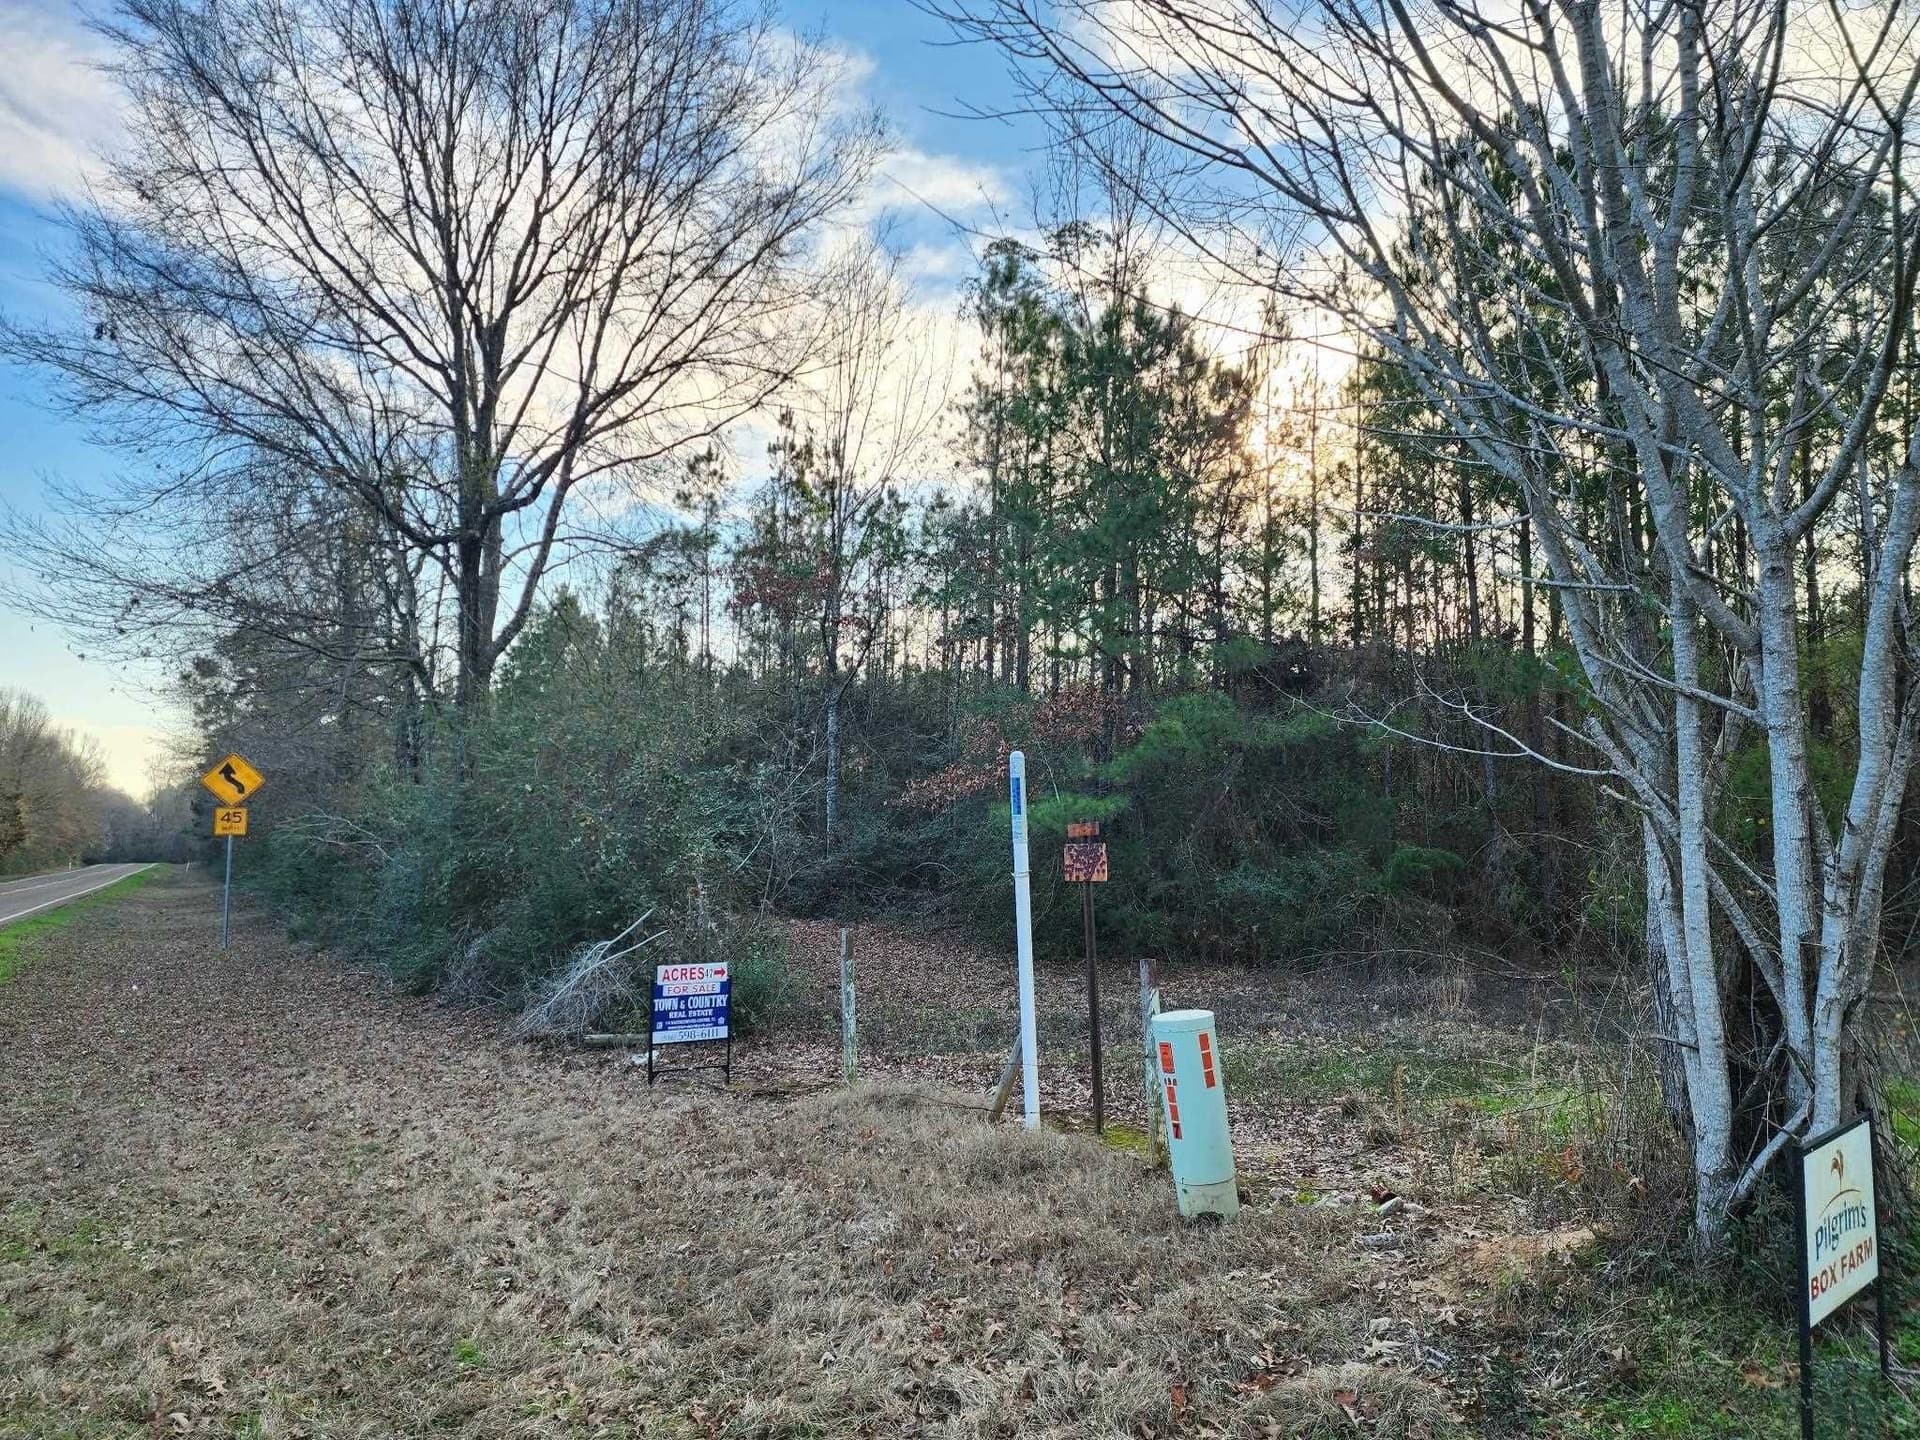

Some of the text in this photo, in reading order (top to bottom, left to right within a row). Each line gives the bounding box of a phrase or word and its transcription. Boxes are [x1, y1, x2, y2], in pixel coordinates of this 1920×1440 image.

[221, 811, 242, 823] 45
[663, 967, 705, 982] ACRES
[667, 984, 716, 994] FOR SALE
[654, 995, 728, 1011] TOWN & COUNTRY
[688, 1009, 713, 1017] ESTATE
[1815, 1200, 1866, 1261] Pilgrim's
[1810, 1237, 1873, 1301] BOX FARM
